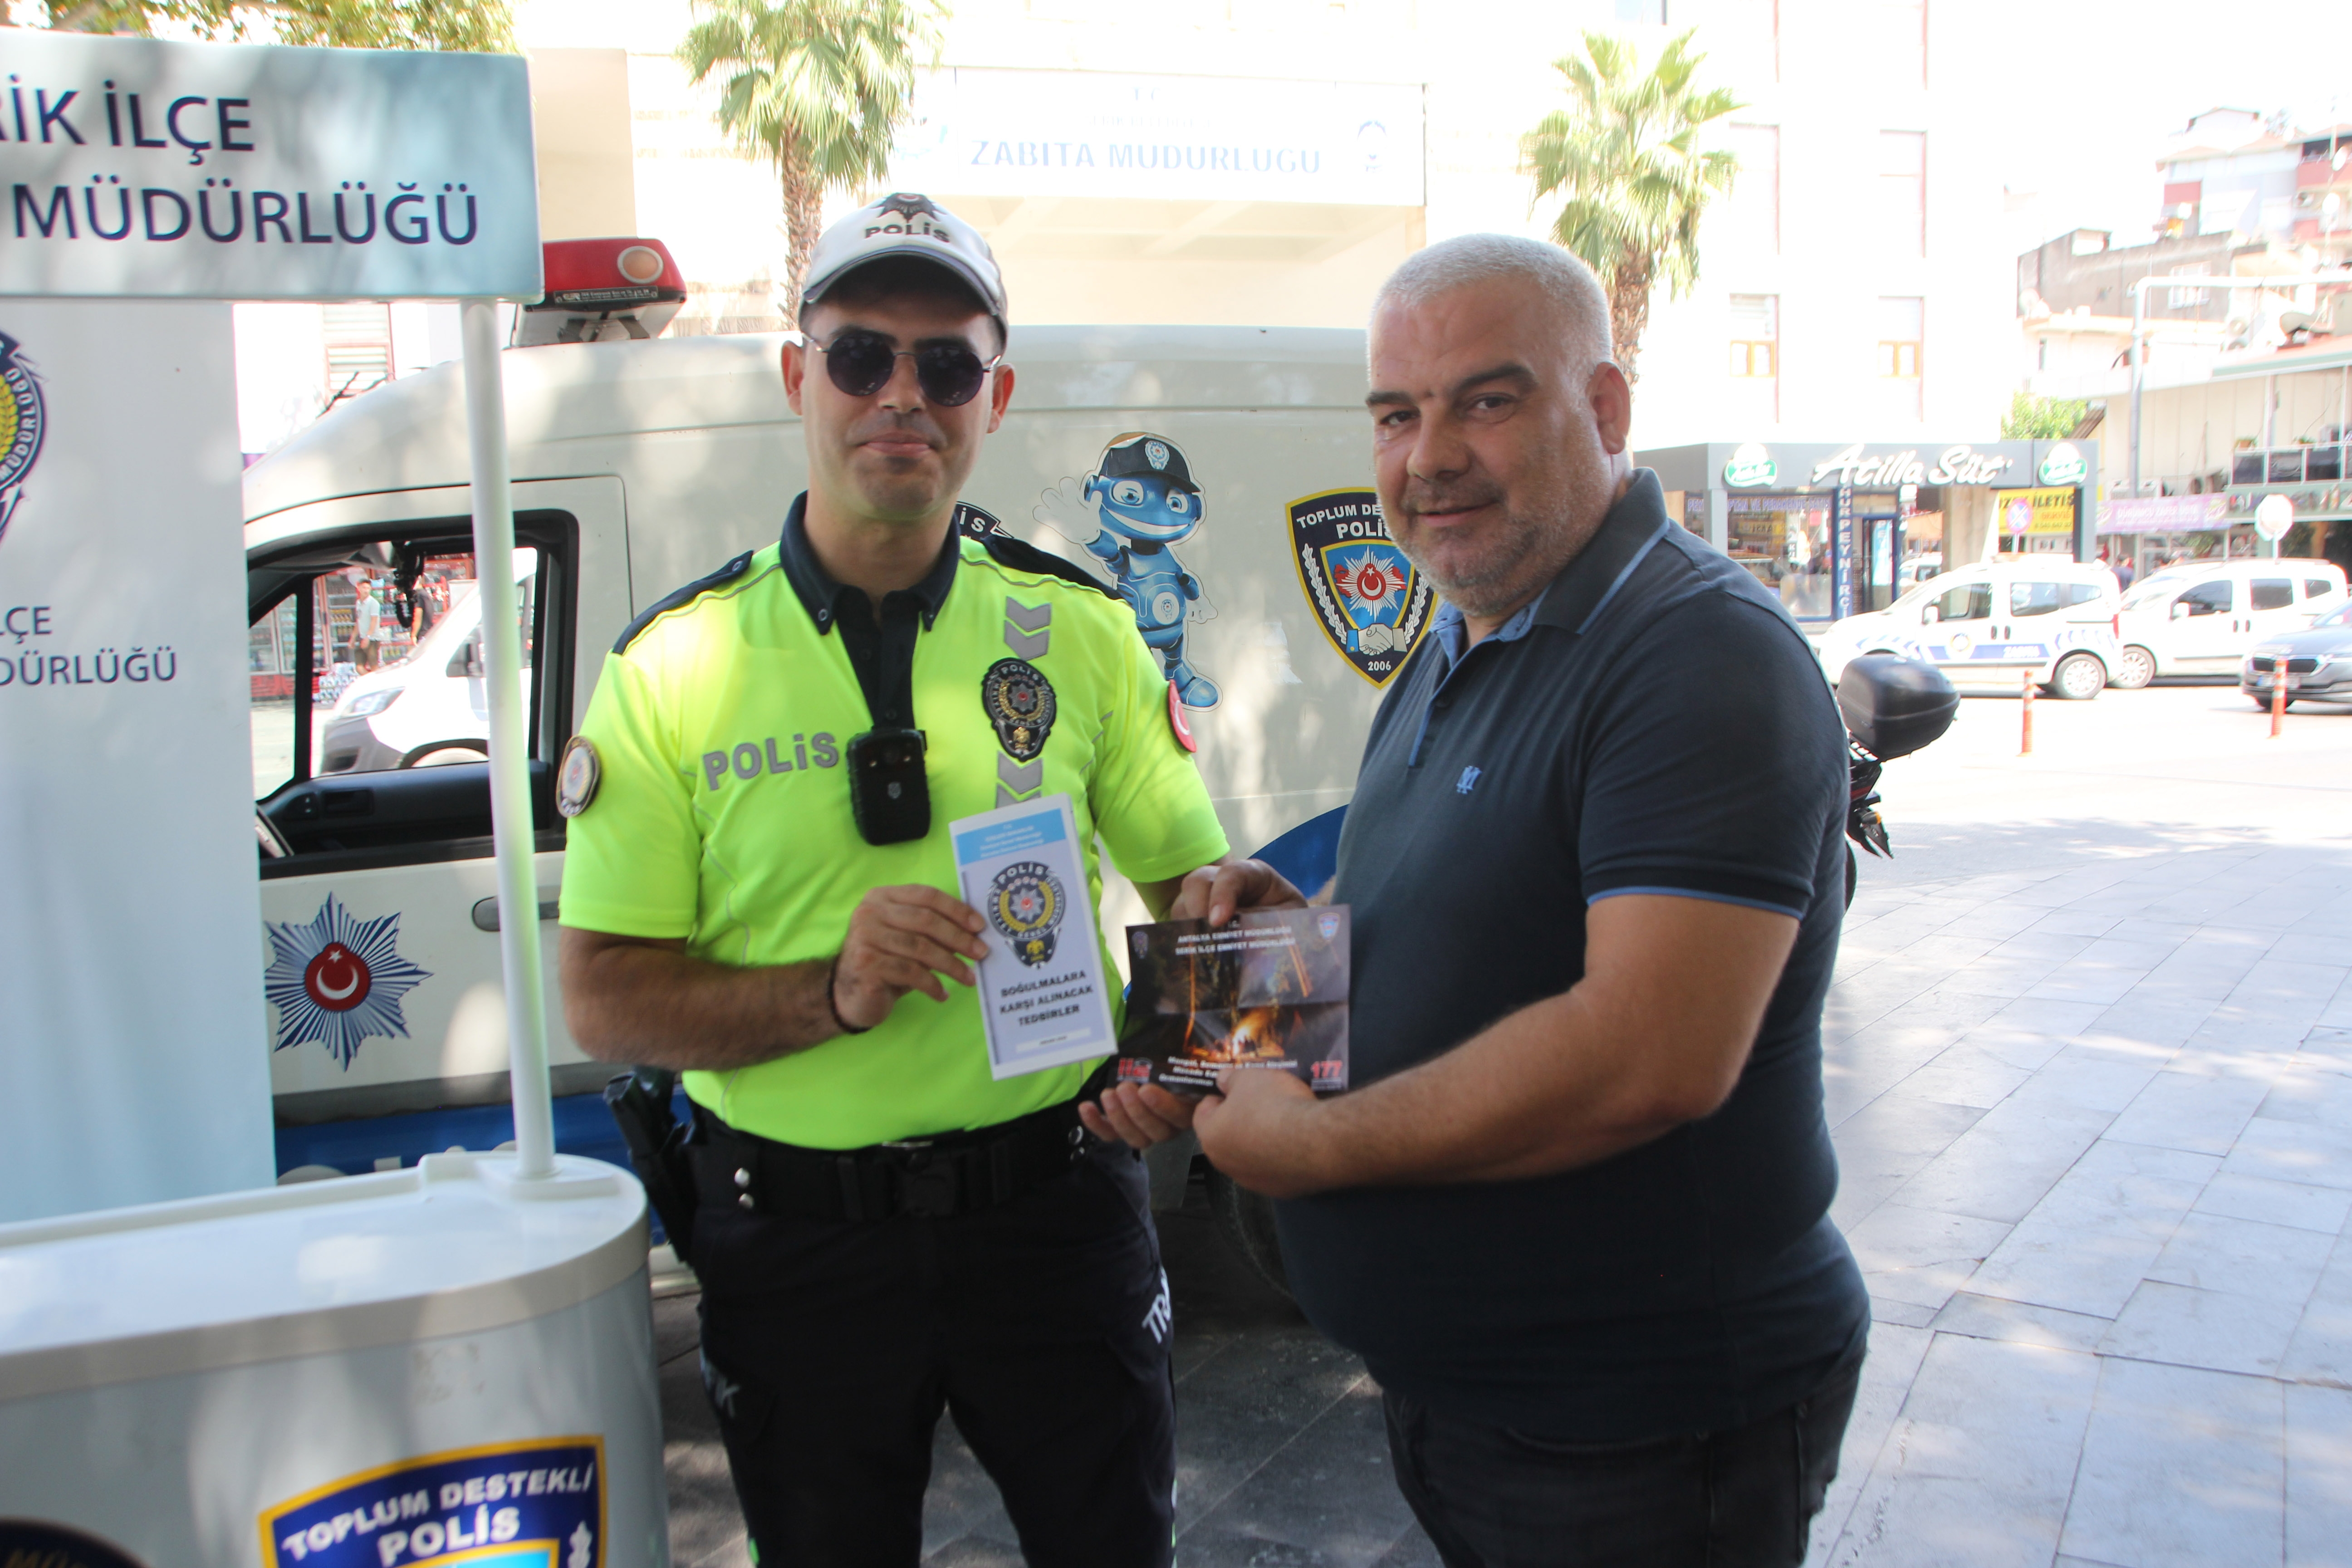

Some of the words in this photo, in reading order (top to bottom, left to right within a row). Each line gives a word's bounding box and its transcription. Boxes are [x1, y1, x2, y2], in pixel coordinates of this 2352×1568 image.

[104, 79, 255, 165] İLÇE
[970, 139, 1095, 168] ZABITA
[14, 174, 478, 245] MÜDÜRLÜĞÜ
[1813, 443, 1923, 486] Atilla
[1928, 444, 2004, 485] Süt
[1296, 504, 1357, 529] TOPLUM
[1728, 499, 1748, 511] PTAN
[0, 605, 53, 645] ÇE
[1367, 661, 1392, 671] 2006
[1310, 1060, 1343, 1078] 177
[280, 1488, 431, 1562] TOPLUM
[439, 1460, 594, 1510] DESTEKLİ
[377, 1504, 522, 1568] POLİS
